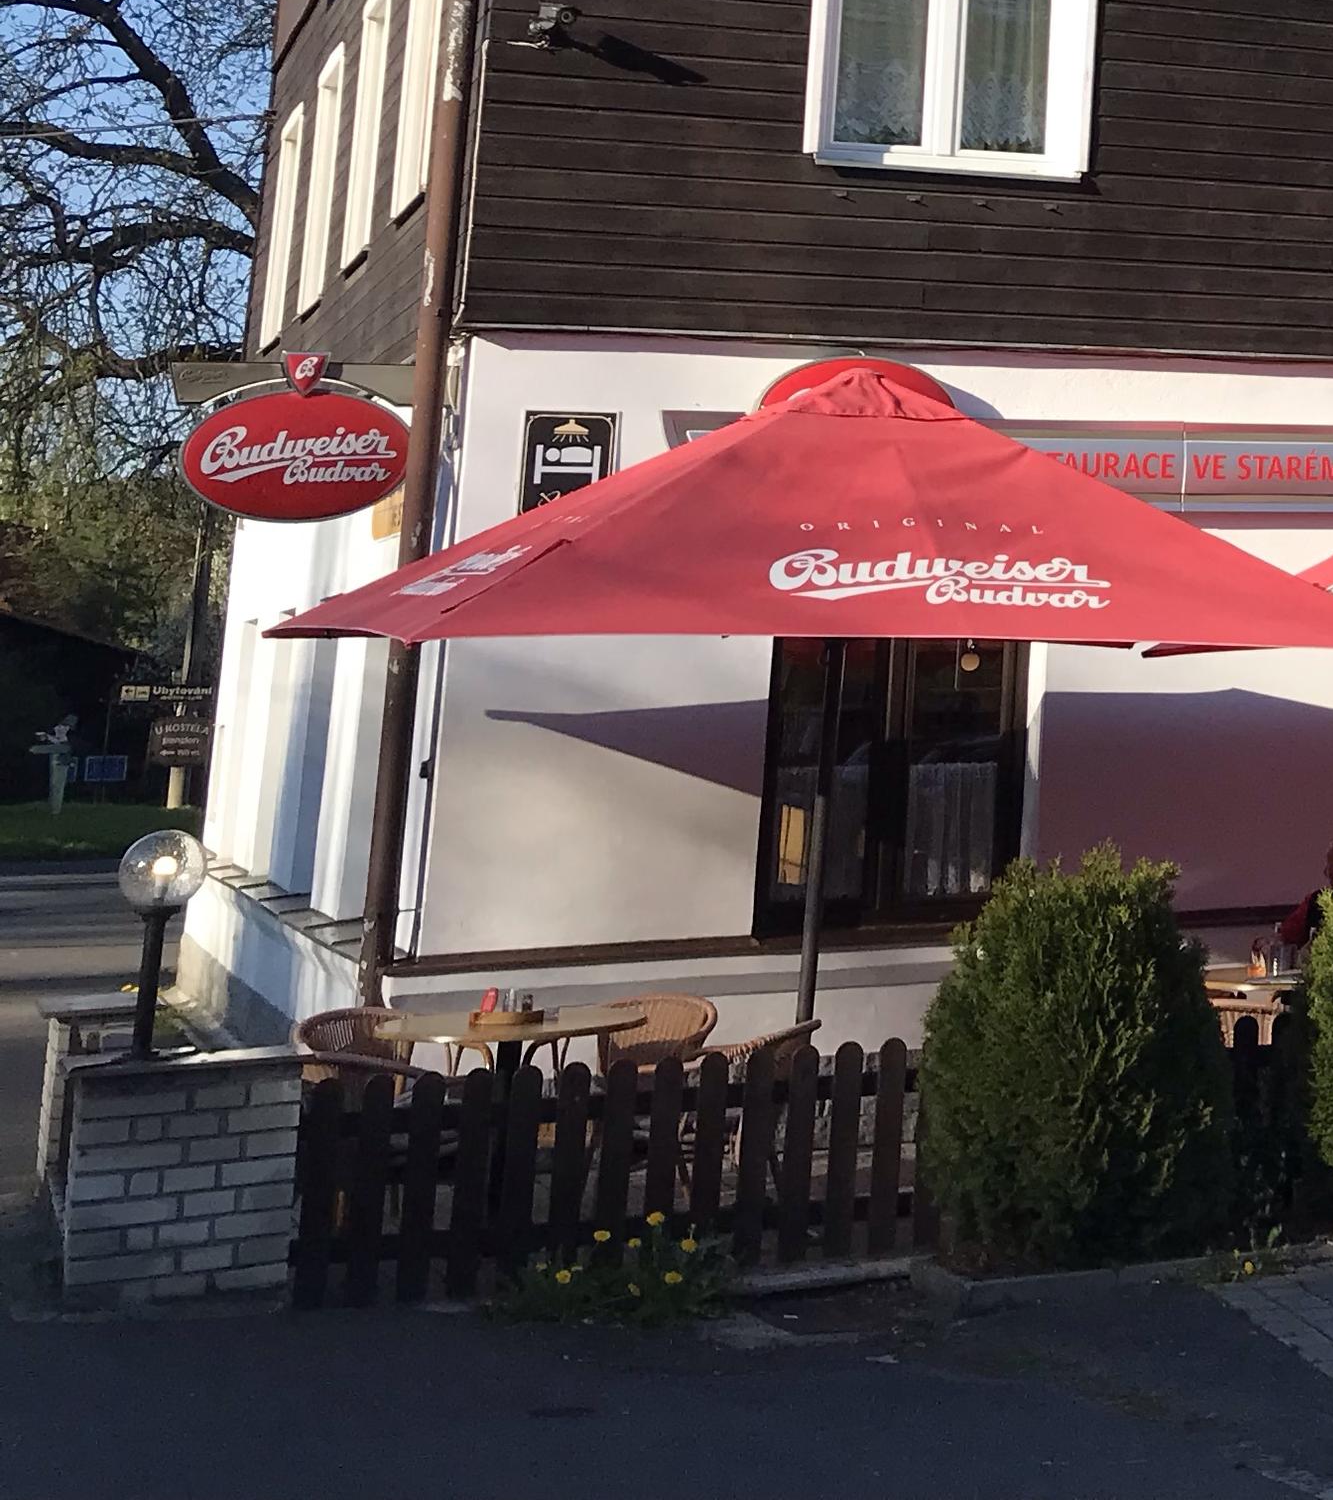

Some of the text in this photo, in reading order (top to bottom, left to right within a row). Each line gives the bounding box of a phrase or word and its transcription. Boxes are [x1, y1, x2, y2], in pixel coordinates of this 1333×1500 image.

[200, 425, 397, 482] Budweiser
[1193, 454, 1227, 480] VE
[283, 456, 391, 485] Budvar
[800, 517, 1044, 535] ORIGINAL
[769, 548, 1111, 600] Budweiser
[925, 576, 1111, 609] Budvar
